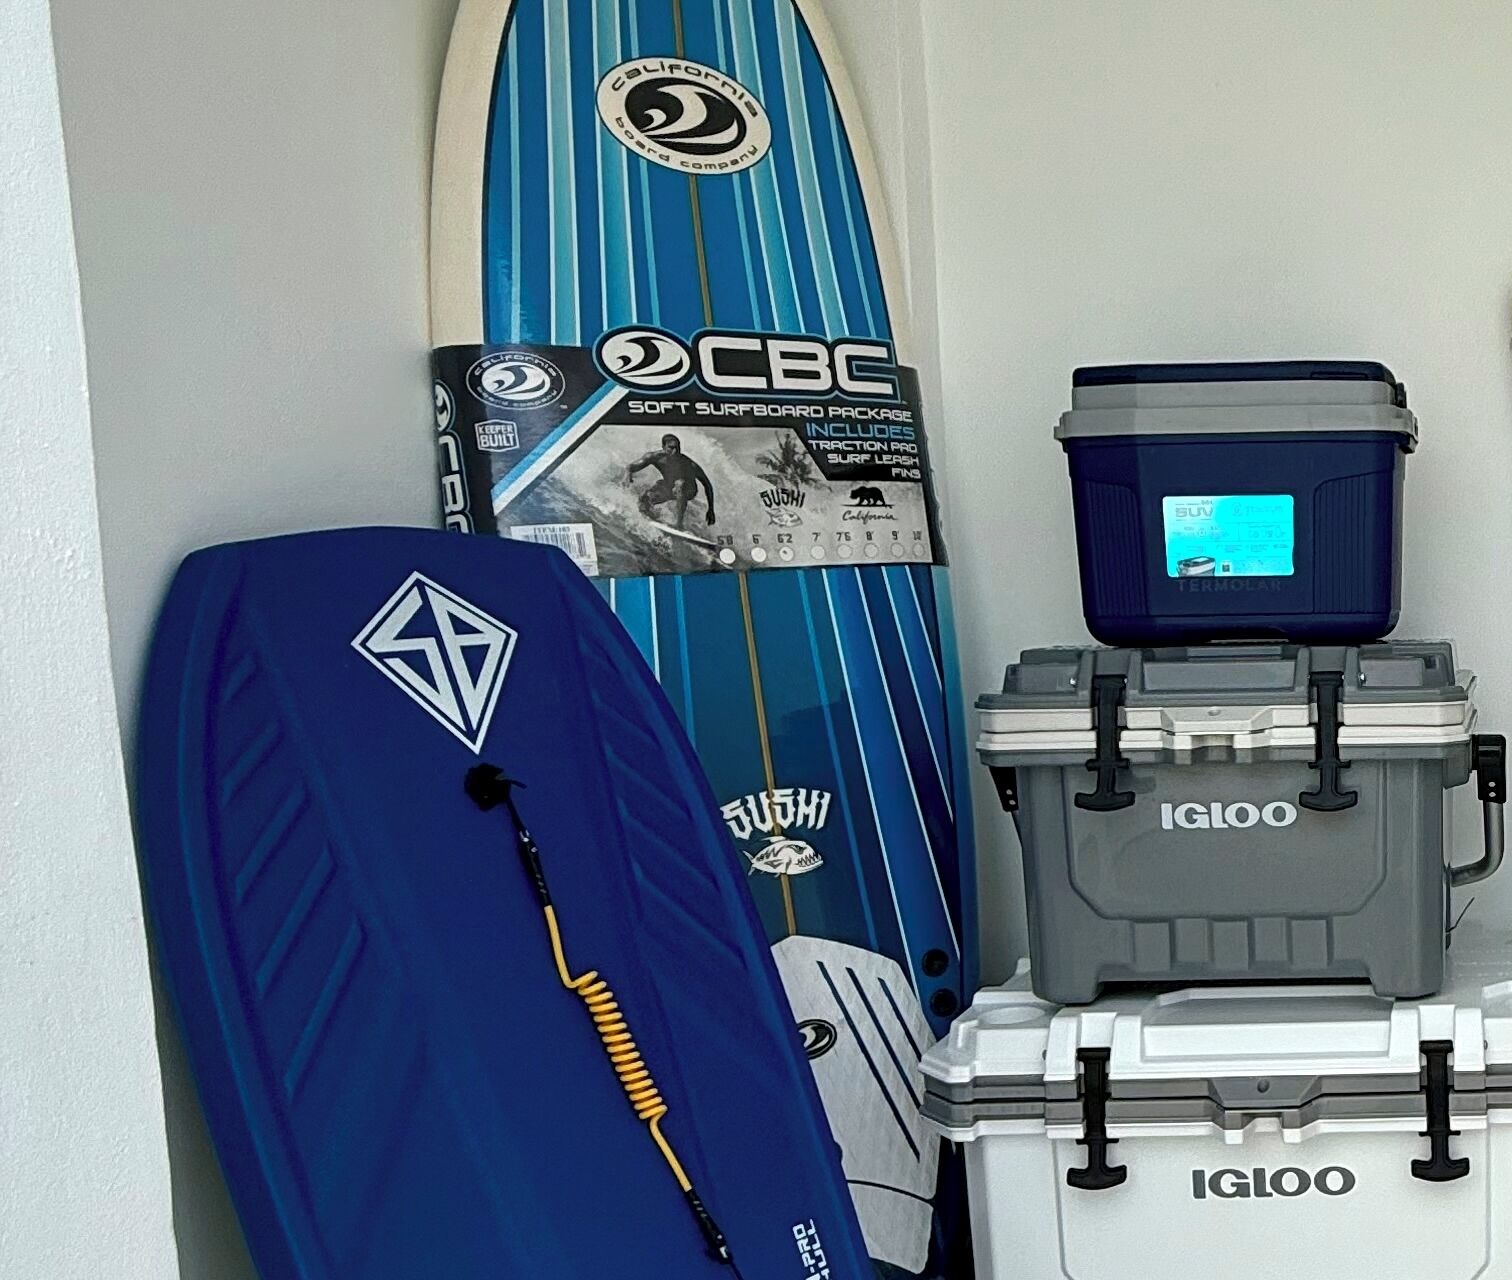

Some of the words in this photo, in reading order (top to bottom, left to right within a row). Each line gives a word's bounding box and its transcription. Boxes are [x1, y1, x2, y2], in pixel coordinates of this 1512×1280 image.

[611, 60, 759, 117] california
[615, 116, 670, 162] board
[680, 144, 759, 171] company
[698, 336, 894, 395] CBC
[628, 400, 690, 415] SOFT
[695, 402, 824, 418] SURFBOARD
[828, 406, 914, 423] PACKAGE
[478, 424, 514, 435] KEEPER
[805, 422, 916, 440] INCLUDES
[480, 432, 515, 448] BUILT
[807, 440, 888, 452] TRACTION
[890, 441, 918, 454] PAD
[826, 453, 871, 464] SURF
[874, 454, 920, 467] LEASH
[891, 467, 922, 480] FINS
[759, 488, 806, 508] SUSHI
[842, 509, 899, 525] California
[1174, 506, 1214, 518] SUV
[719, 787, 832, 840] SUSHI
[1160, 801, 1298, 830] IGLOO
[1191, 1166, 1356, 1199] IGLOO
